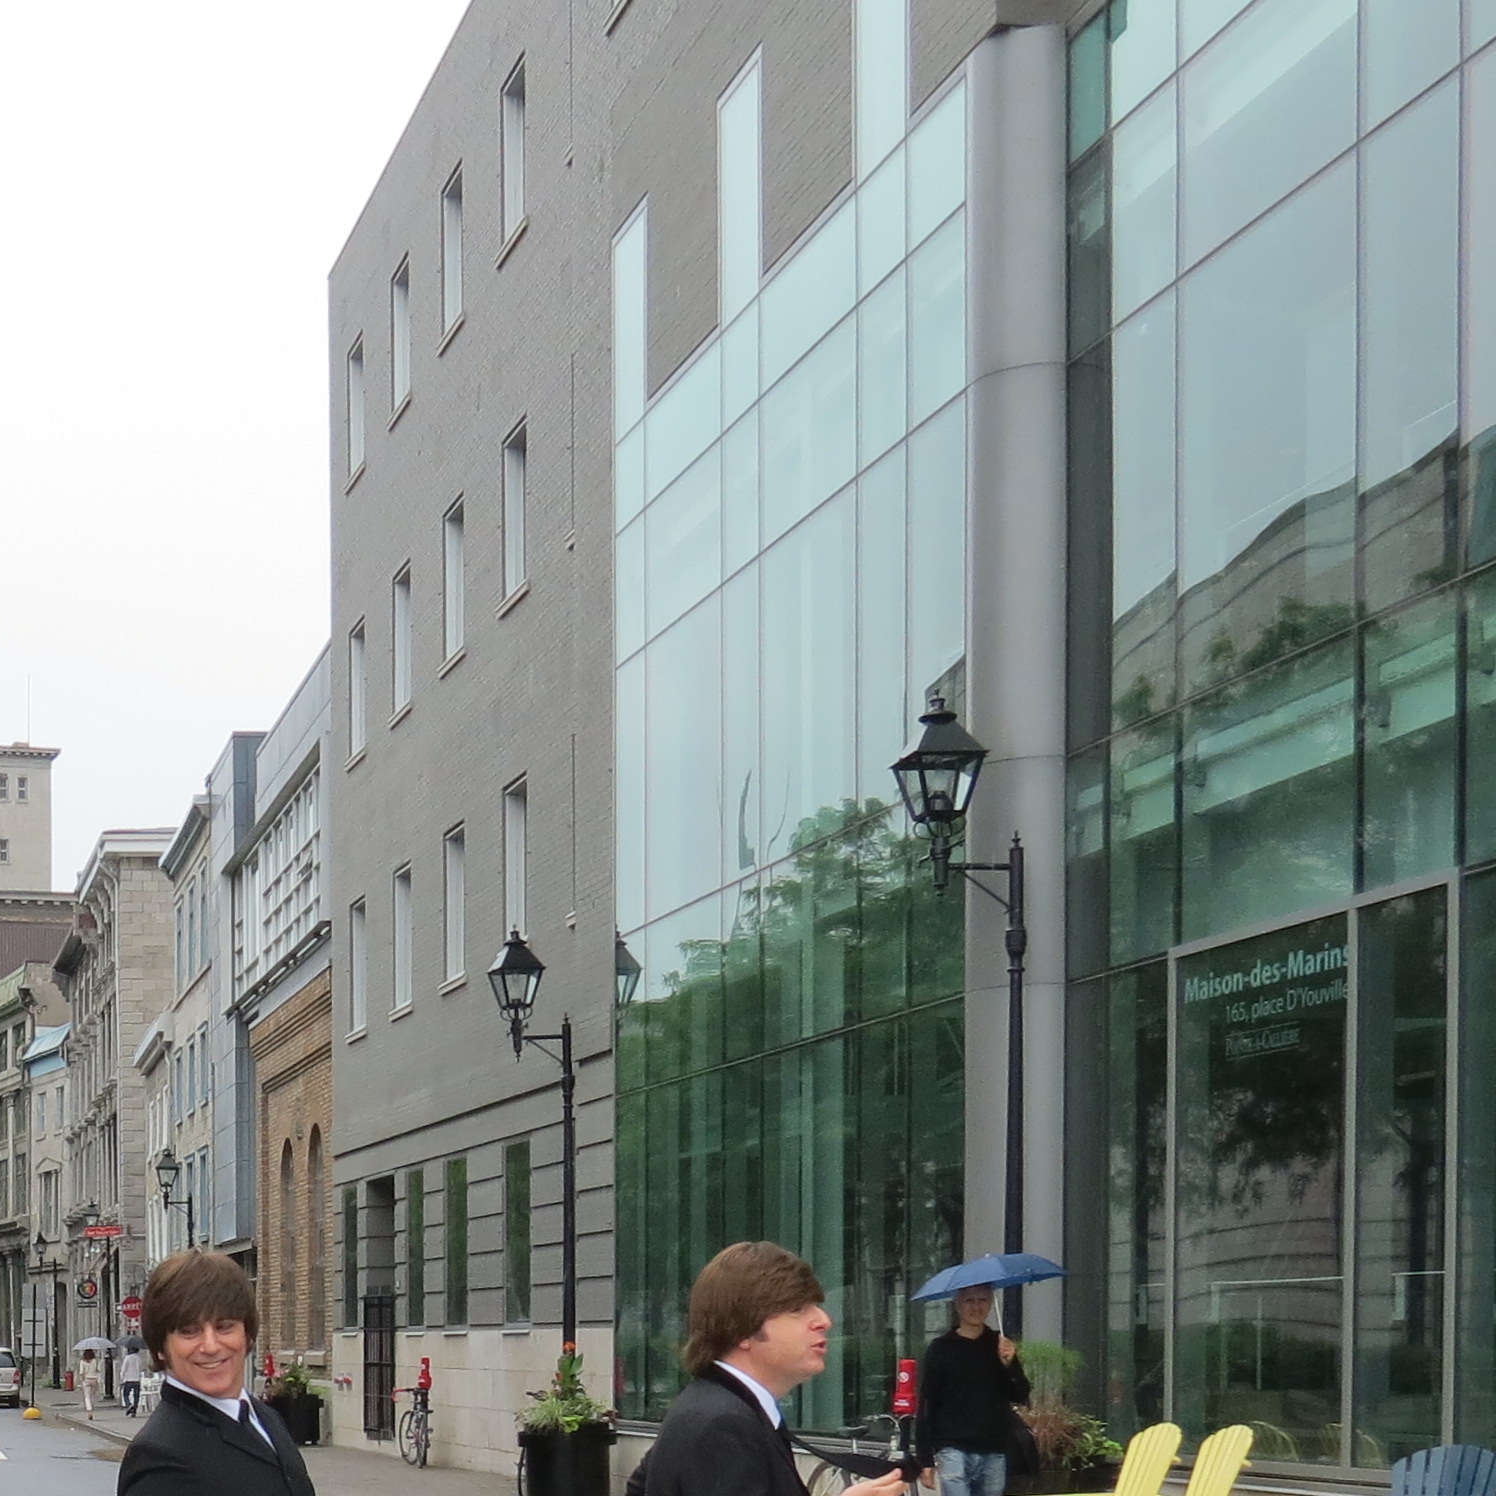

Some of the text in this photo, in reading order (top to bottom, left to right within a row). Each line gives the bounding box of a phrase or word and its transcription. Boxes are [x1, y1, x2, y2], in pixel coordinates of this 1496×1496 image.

[1185, 943, 1348, 1002] Maison-des-Marins
[1226, 979, 1348, 1024] 165, place D'Youville
